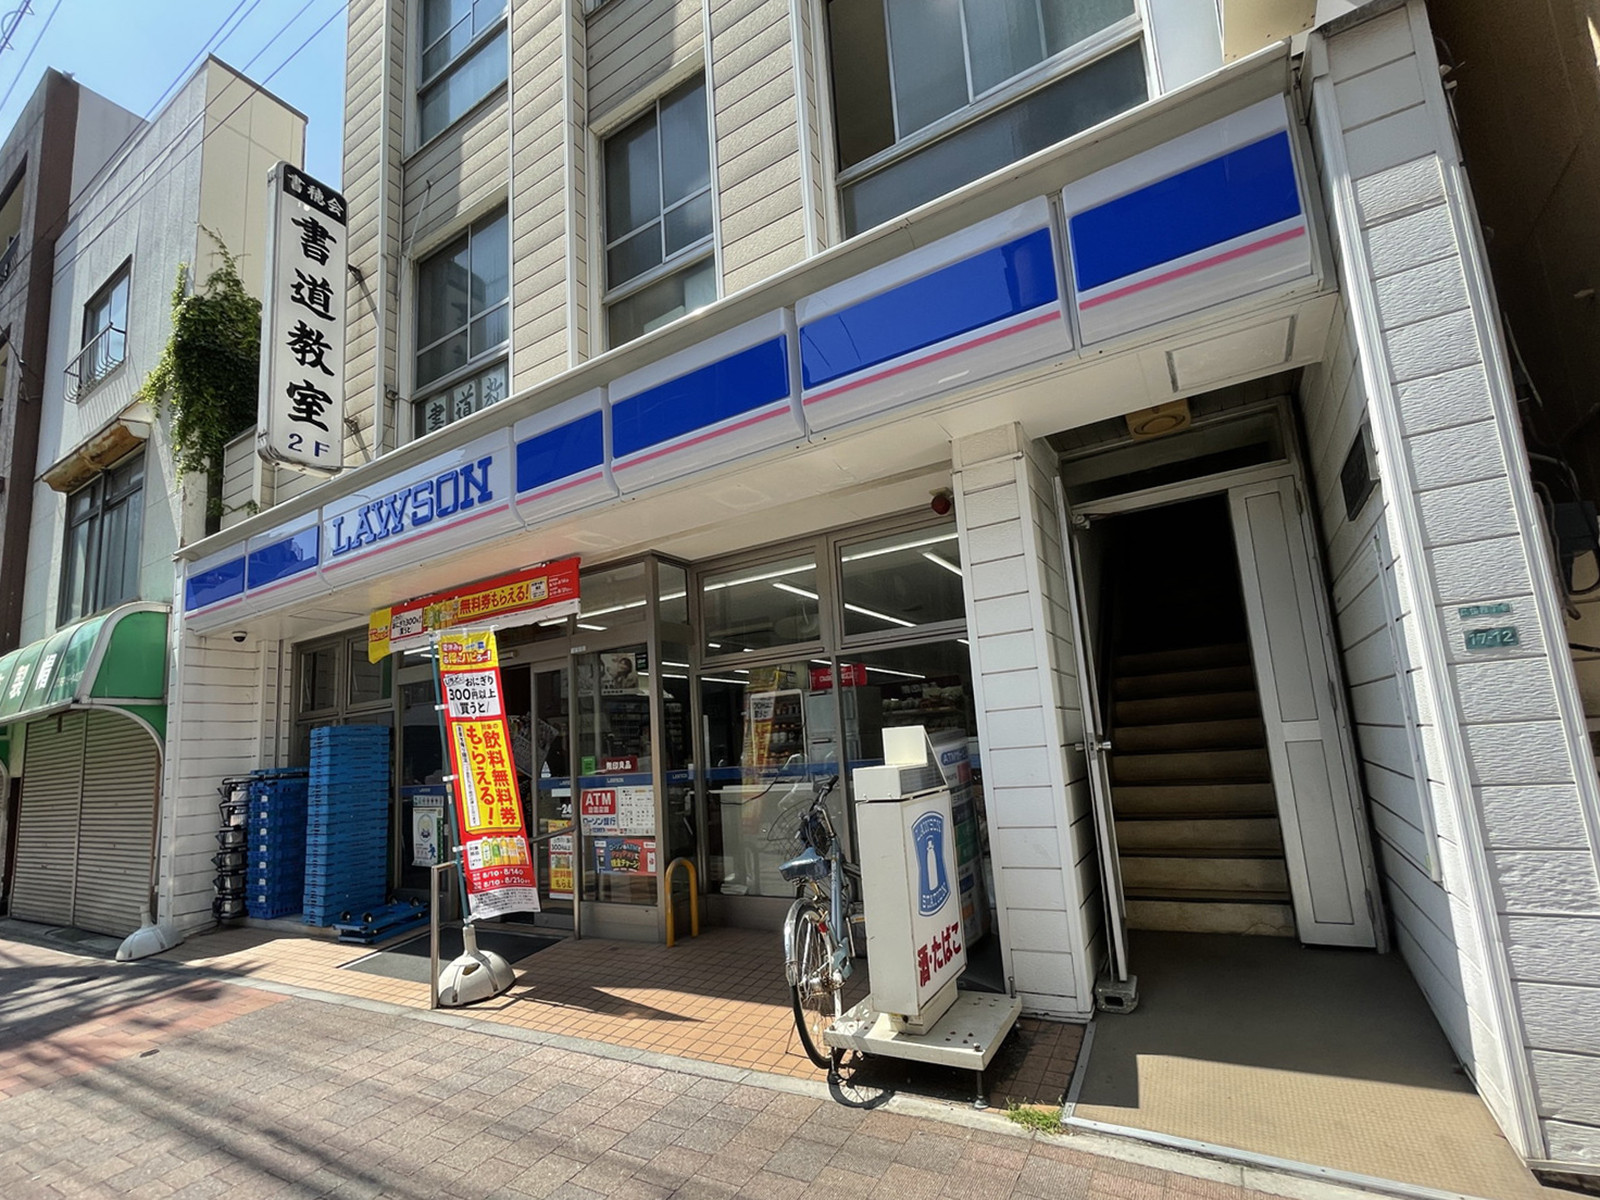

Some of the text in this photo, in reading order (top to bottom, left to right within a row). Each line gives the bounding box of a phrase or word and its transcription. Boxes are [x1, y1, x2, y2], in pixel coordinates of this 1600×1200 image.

[286, 216, 337, 432] 書道教室
[332, 455, 493, 557] LAWSON
[1468, 630, 1514, 646] 17-12
[465, 676, 494, 687] おにぎり
[448, 687, 497, 701] 300円以上
[460, 702, 486, 715] 買うと
[605, 759, 632, 770] 無印良品
[482, 730, 517, 826] 飲料無料券
[585, 792, 612, 806] ATM
